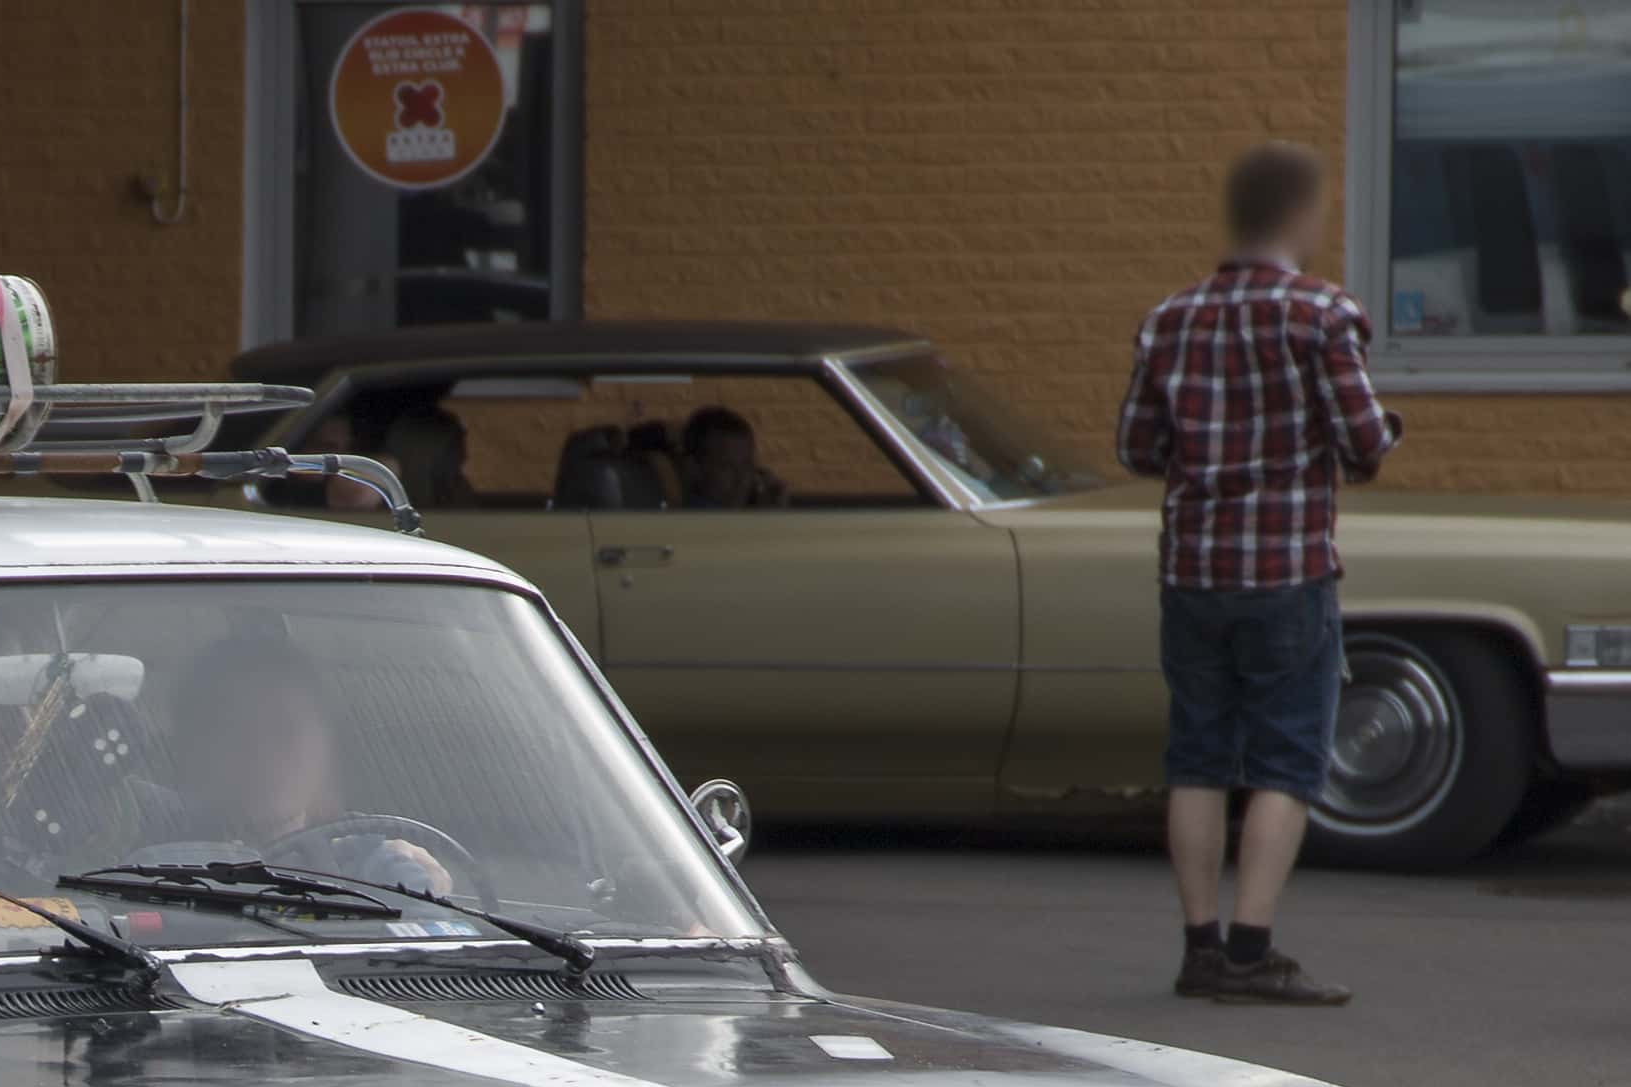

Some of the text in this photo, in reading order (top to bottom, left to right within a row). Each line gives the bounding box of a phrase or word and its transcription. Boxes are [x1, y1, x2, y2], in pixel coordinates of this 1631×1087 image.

[421, 32, 469, 45] EXTRA
[402, 46, 450, 59] CIRCLE
[372, 61, 418, 75] EXTRA
